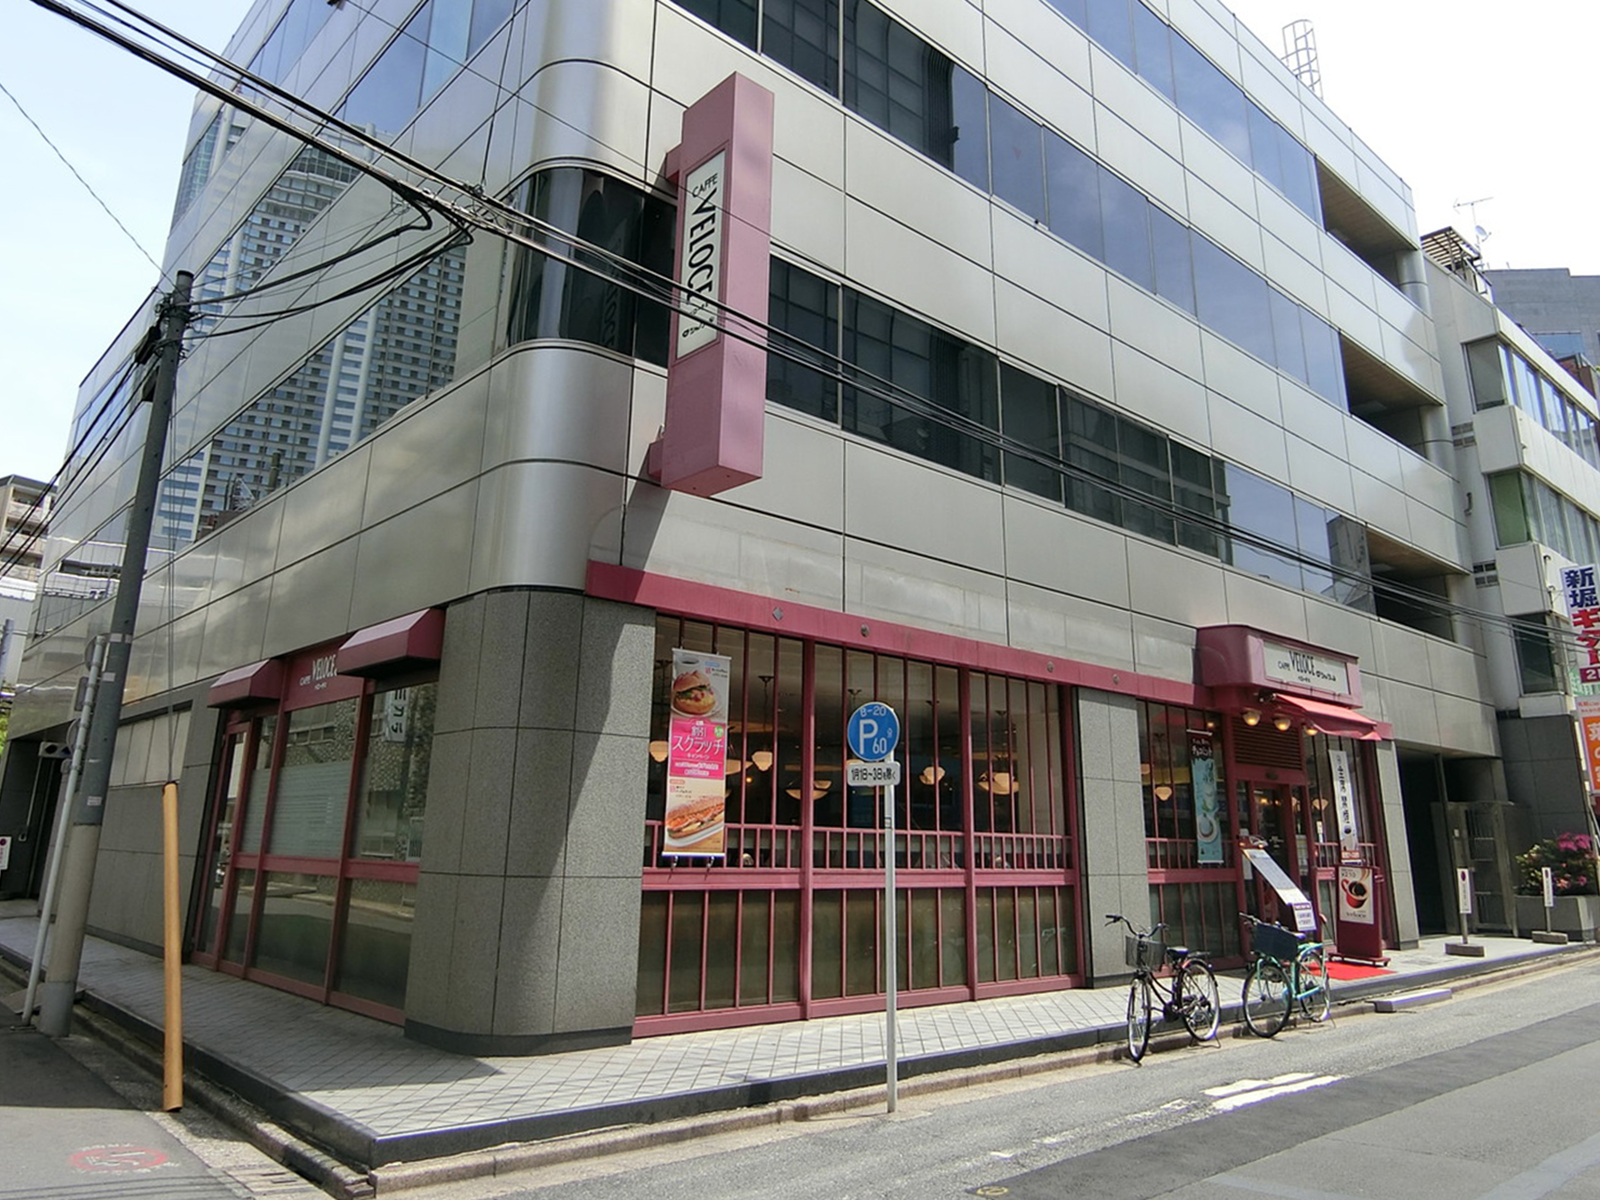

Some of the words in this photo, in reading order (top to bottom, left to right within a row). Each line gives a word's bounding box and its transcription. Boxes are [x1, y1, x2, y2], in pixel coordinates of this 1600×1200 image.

[692, 173, 718, 198] CAFFE
[687, 188, 718, 304] VELOCE
[312, 654, 337, 680] VELOCE
[1289, 651, 1315, 676] VELOCE
[672, 735, 724, 755] スクラッチ
[859, 719, 879, 755] P
[872, 738, 887, 754] 60
